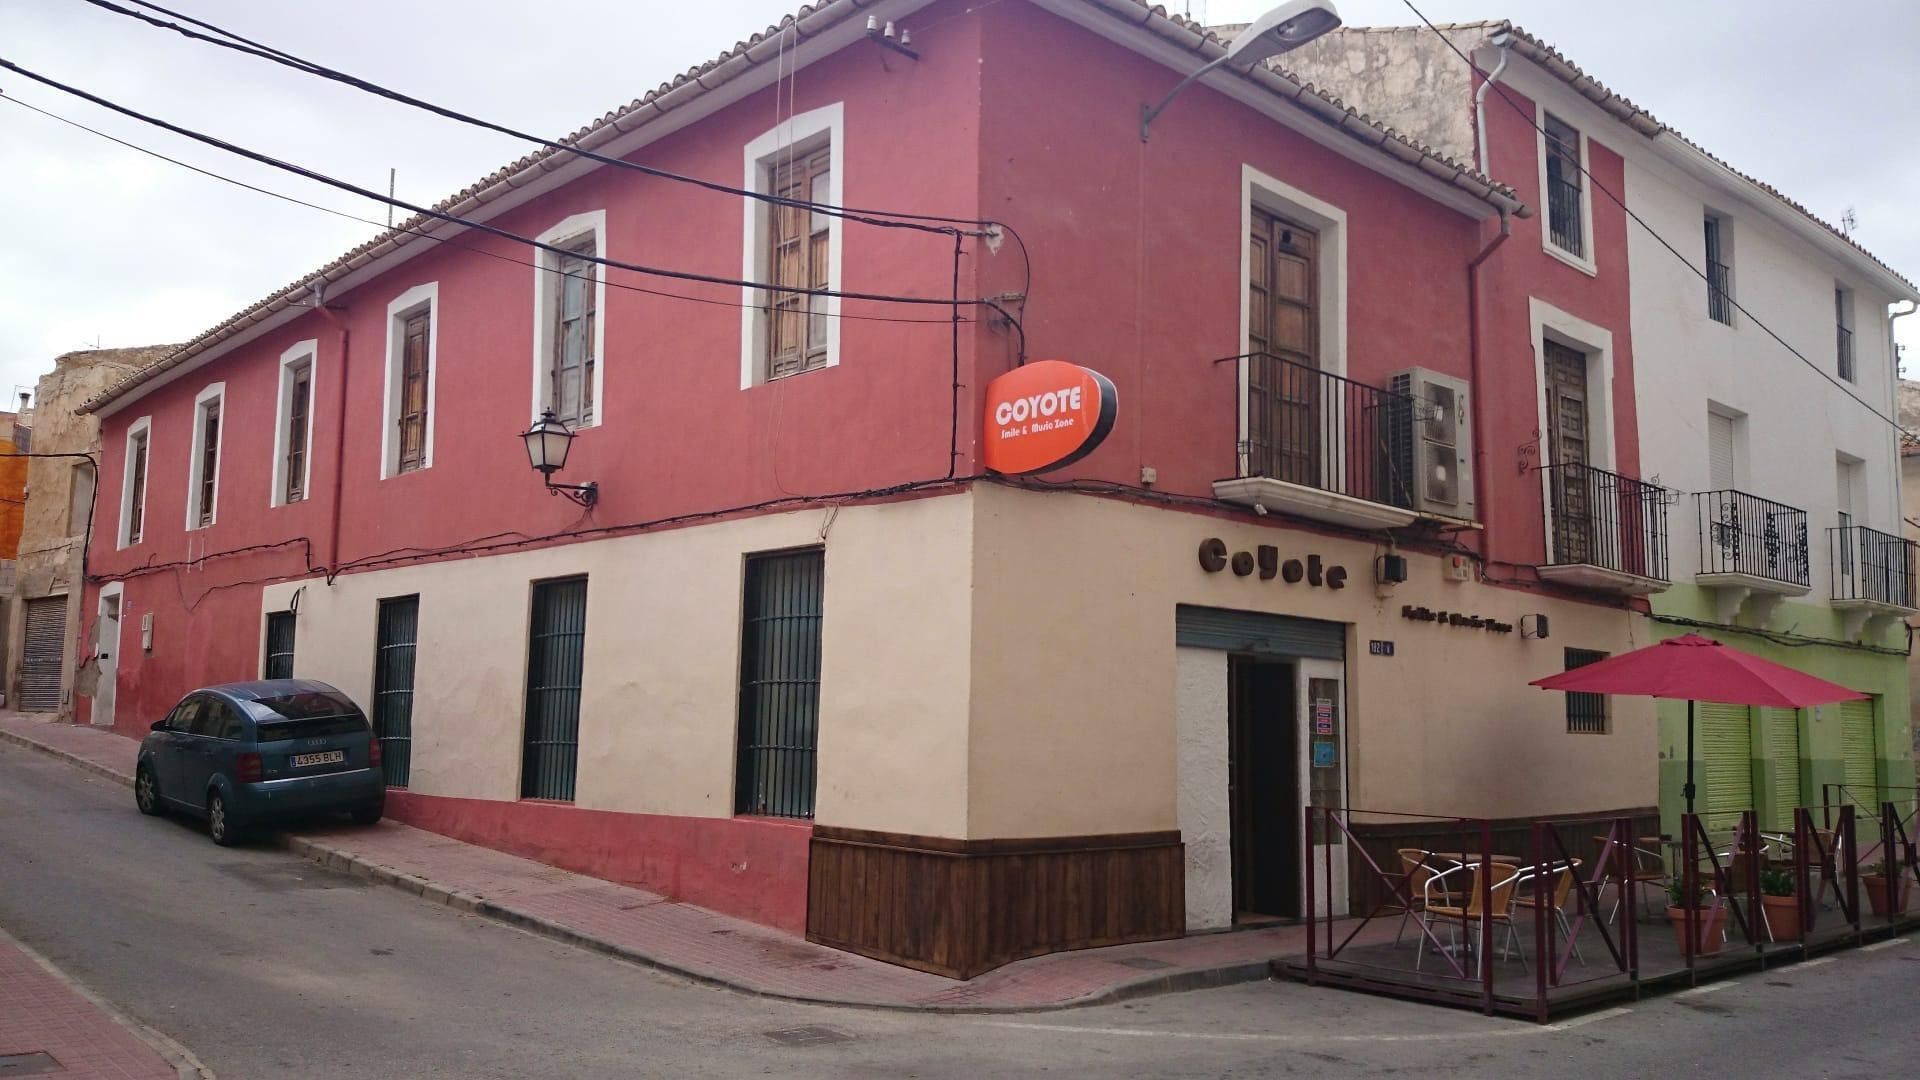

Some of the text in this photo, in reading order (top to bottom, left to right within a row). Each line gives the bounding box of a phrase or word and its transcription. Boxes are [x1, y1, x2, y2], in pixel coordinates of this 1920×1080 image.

[995, 386, 1081, 425] COYOTE
[1001, 417, 1074, 440] Smile & Music Zone
[323, 751, 342, 762] BLH
